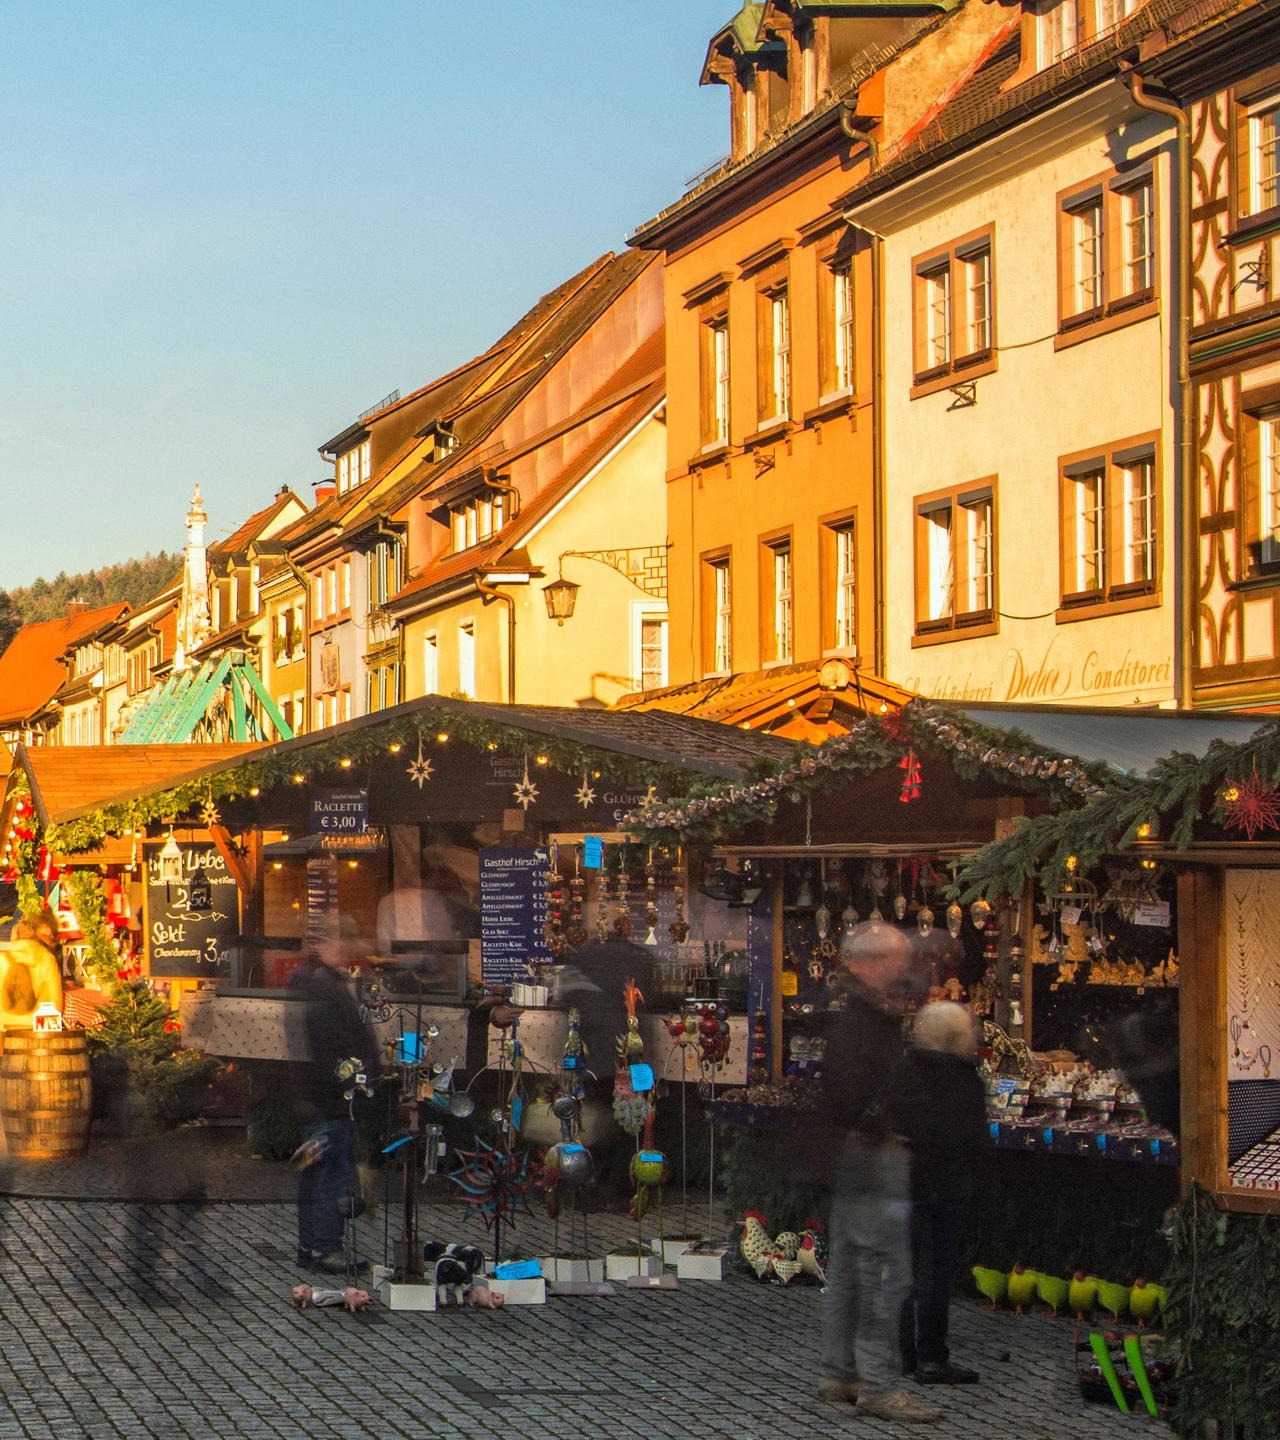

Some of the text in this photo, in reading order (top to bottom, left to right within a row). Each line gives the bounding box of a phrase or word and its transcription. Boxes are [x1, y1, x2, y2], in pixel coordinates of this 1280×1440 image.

[1081, 649, 1171, 691] Conditorei
[321, 816, 356, 830] € 3,00
[187, 849, 225, 872] Liebe
[484, 858, 513, 867] Gasthof
[152, 922, 187, 945] Sekt
[154, 948, 200, 963] Chardonnay
